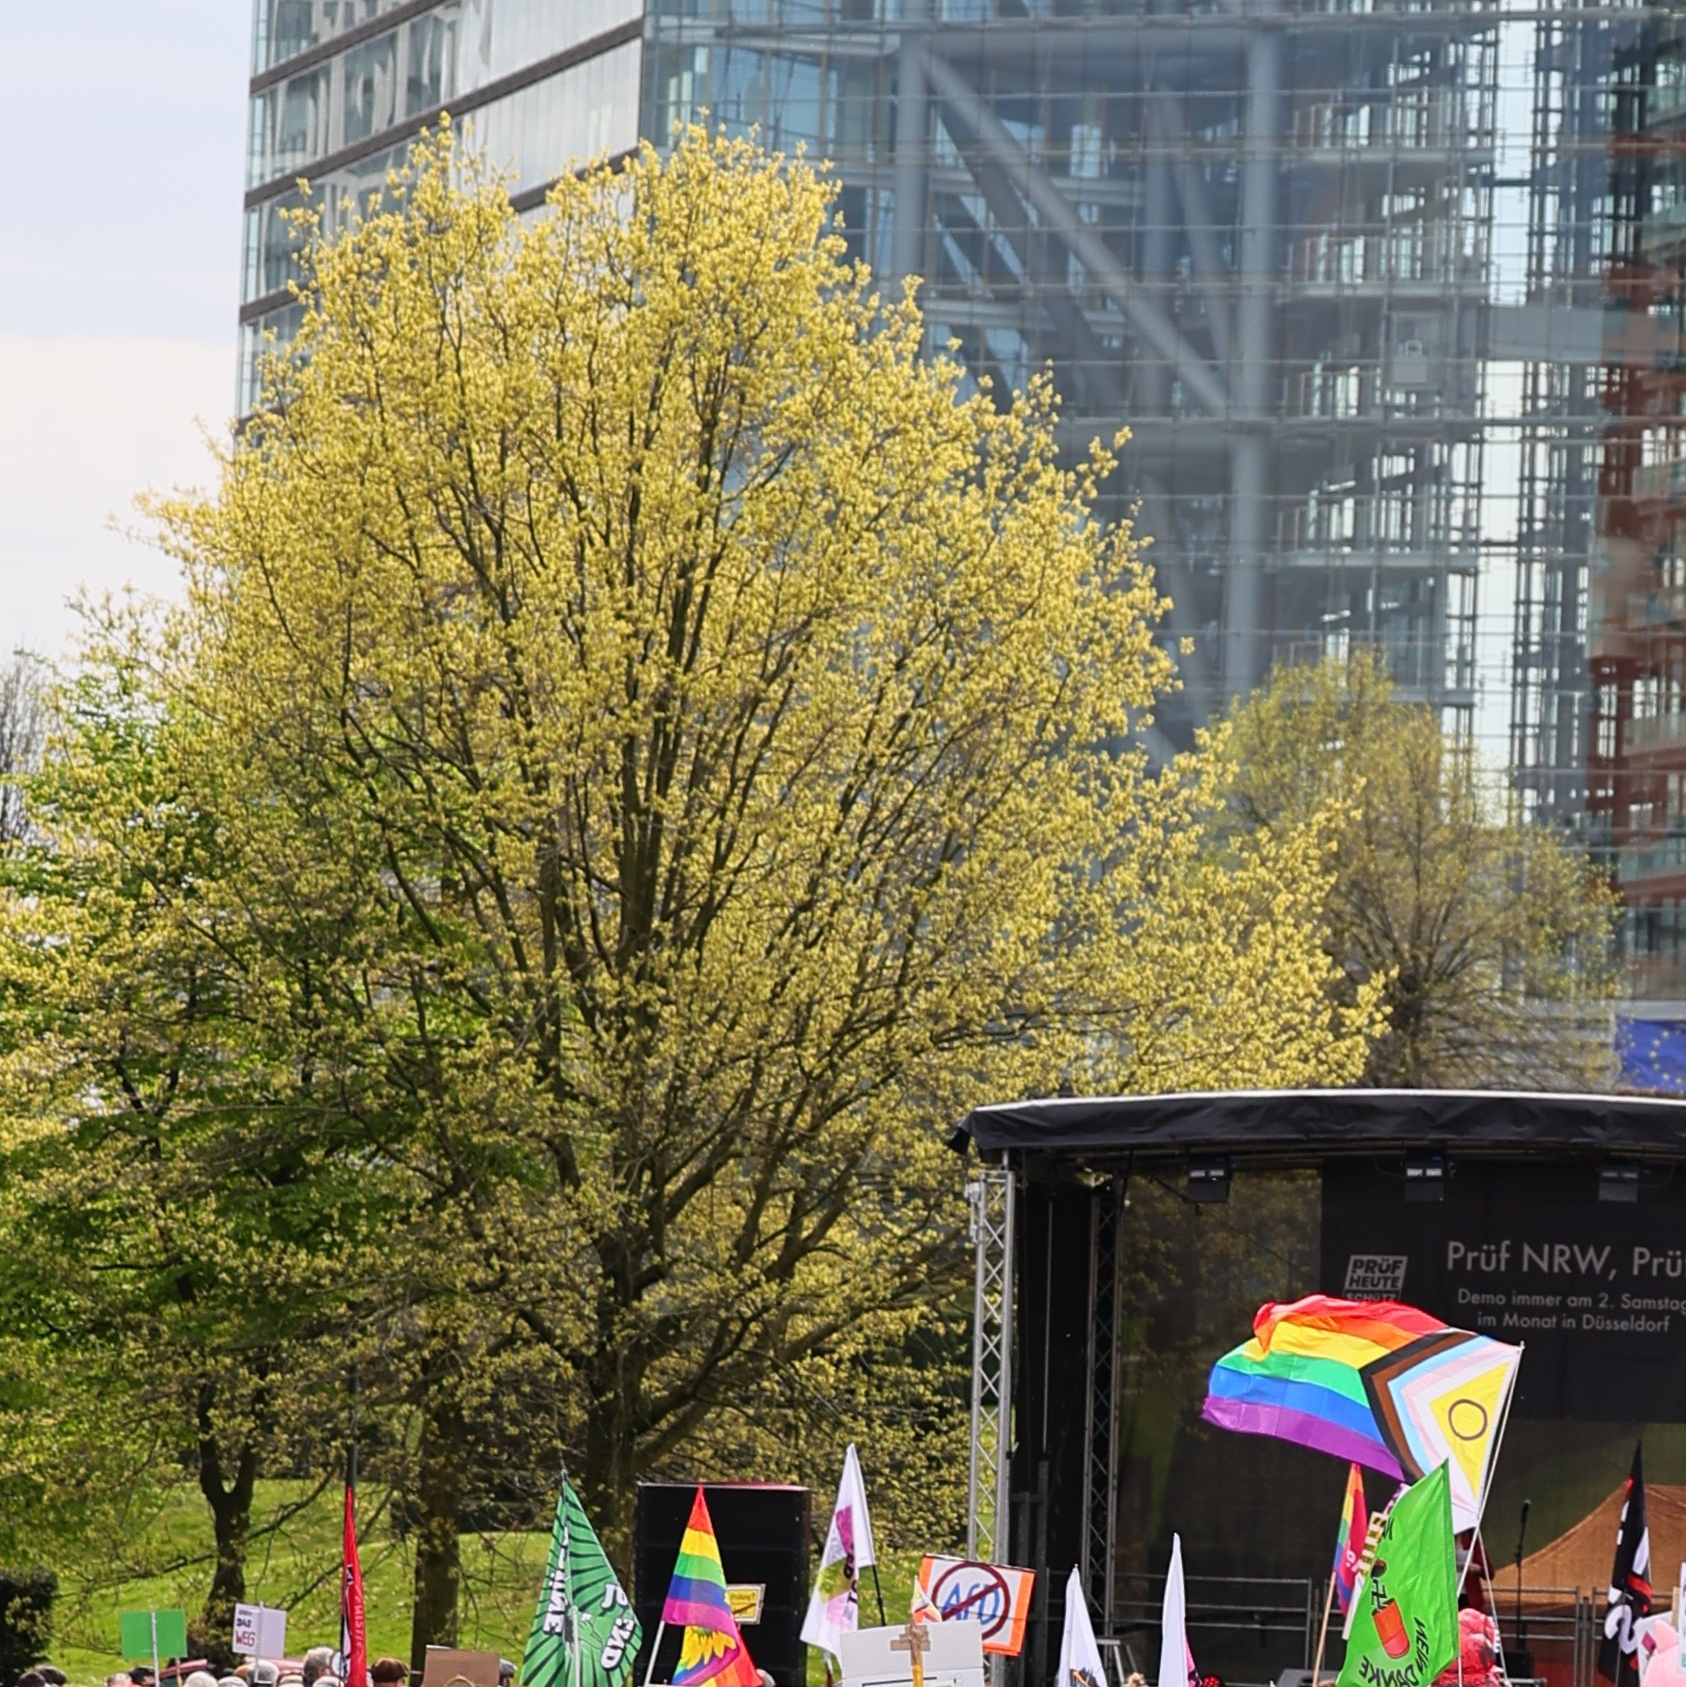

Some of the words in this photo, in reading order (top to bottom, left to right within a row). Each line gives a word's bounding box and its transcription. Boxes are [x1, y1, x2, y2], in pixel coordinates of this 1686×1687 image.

[1351, 1258, 1404, 1274] PRÜF
[1446, 1240, 1511, 1272] Prüf
[1521, 1241, 1617, 1281] NRW,
[1348, 1275, 1401, 1289] HEUTE
[1457, 1287, 1506, 1306] Demo
[1511, 1290, 1563, 1308] immer
[1567, 1294, 1593, 1309] am
[1598, 1291, 1615, 1309] 2.
[1477, 1311, 1497, 1328] im
[1502, 1312, 1558, 1330] Monat
[1561, 1312, 1578, 1329] in
[1581, 1313, 1671, 1333] Düsseldorf
[941, 1580, 1000, 1625] AfD
